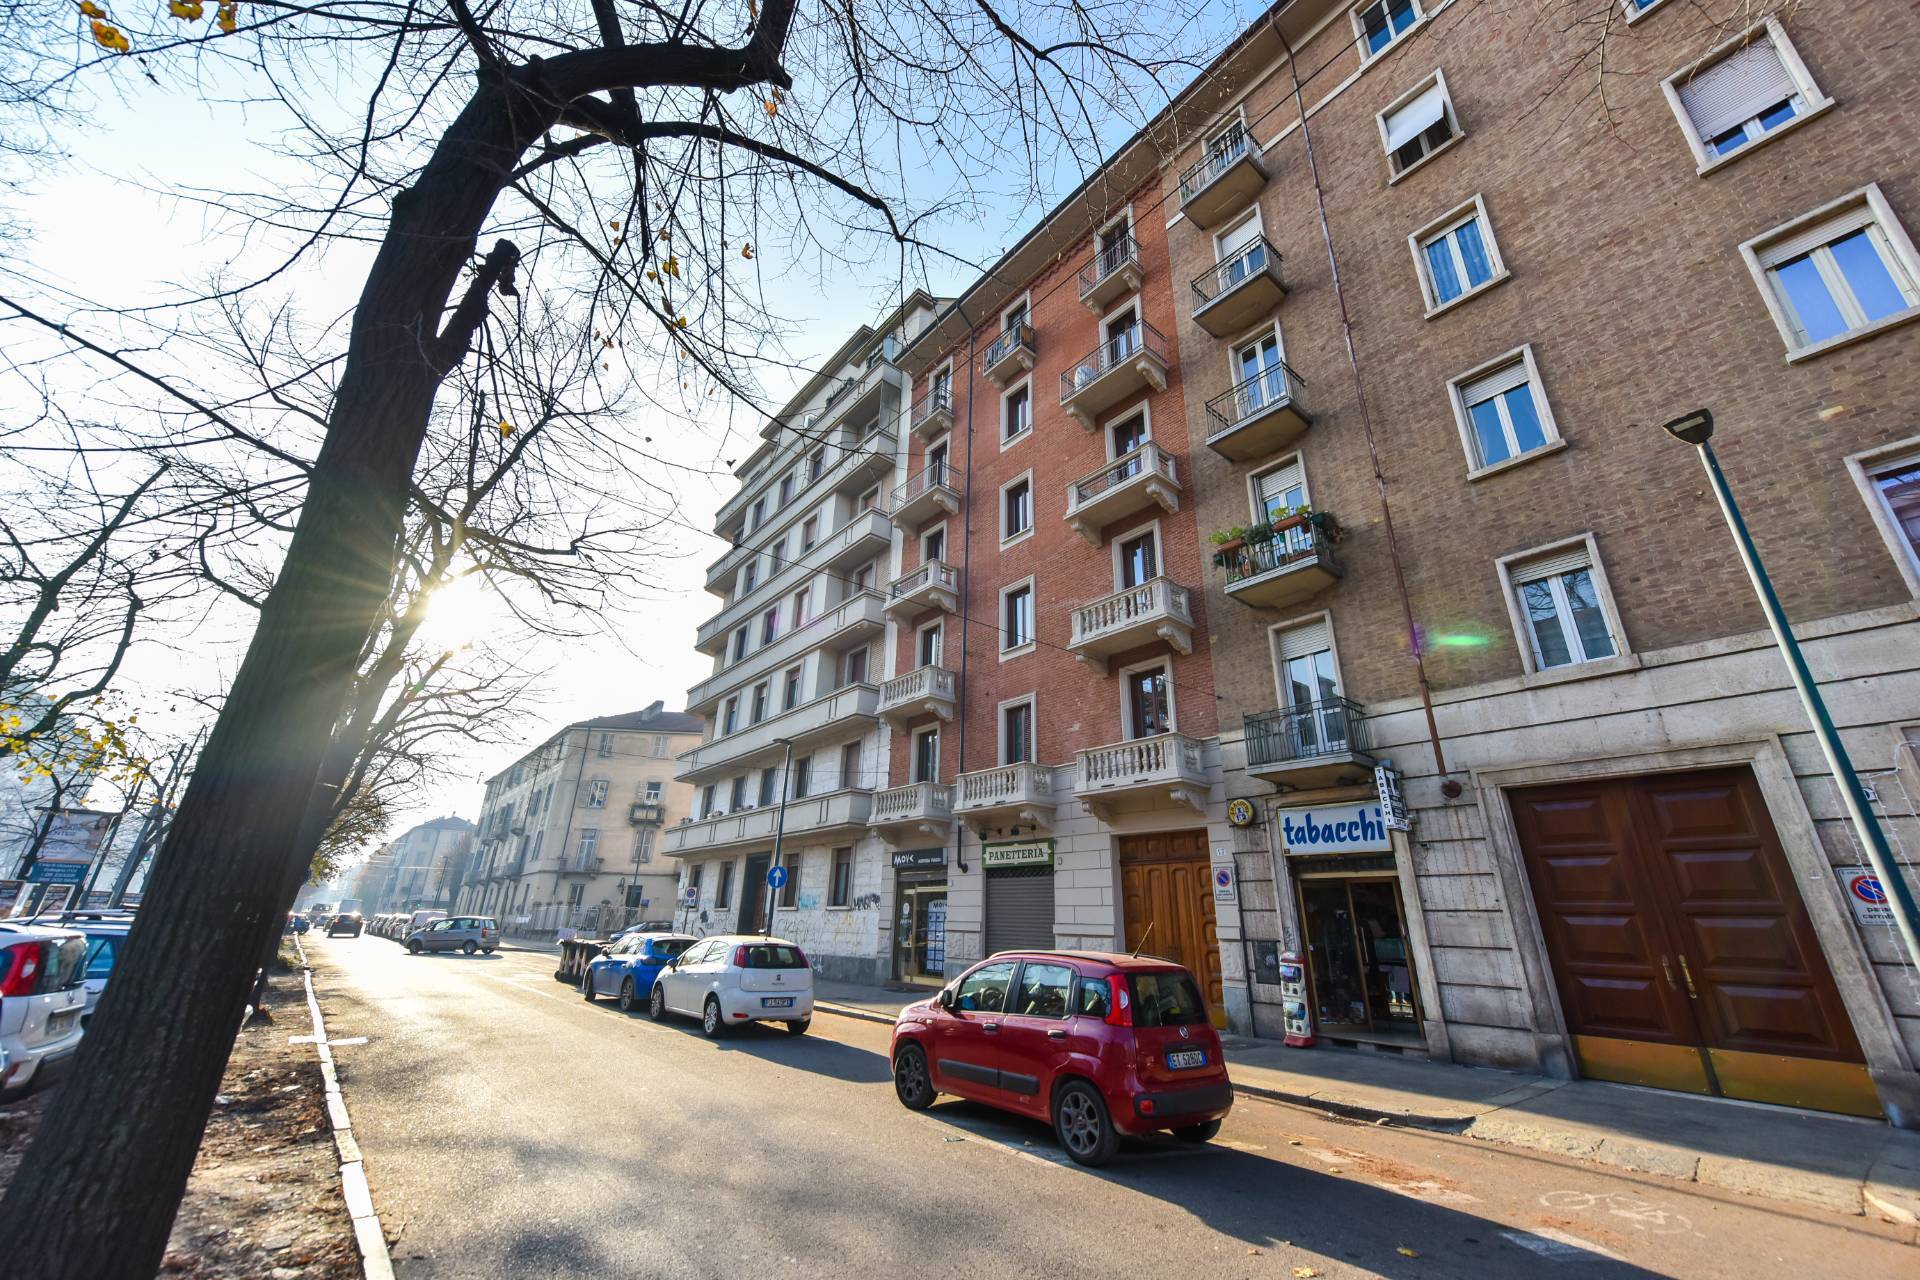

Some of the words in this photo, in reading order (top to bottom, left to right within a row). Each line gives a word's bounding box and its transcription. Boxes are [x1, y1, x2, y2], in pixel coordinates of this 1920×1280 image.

[1376, 768, 1392, 824] TABACCHI
[1283, 808, 1386, 845] tabacchi
[988, 847, 1045, 862] PANETTERIA
